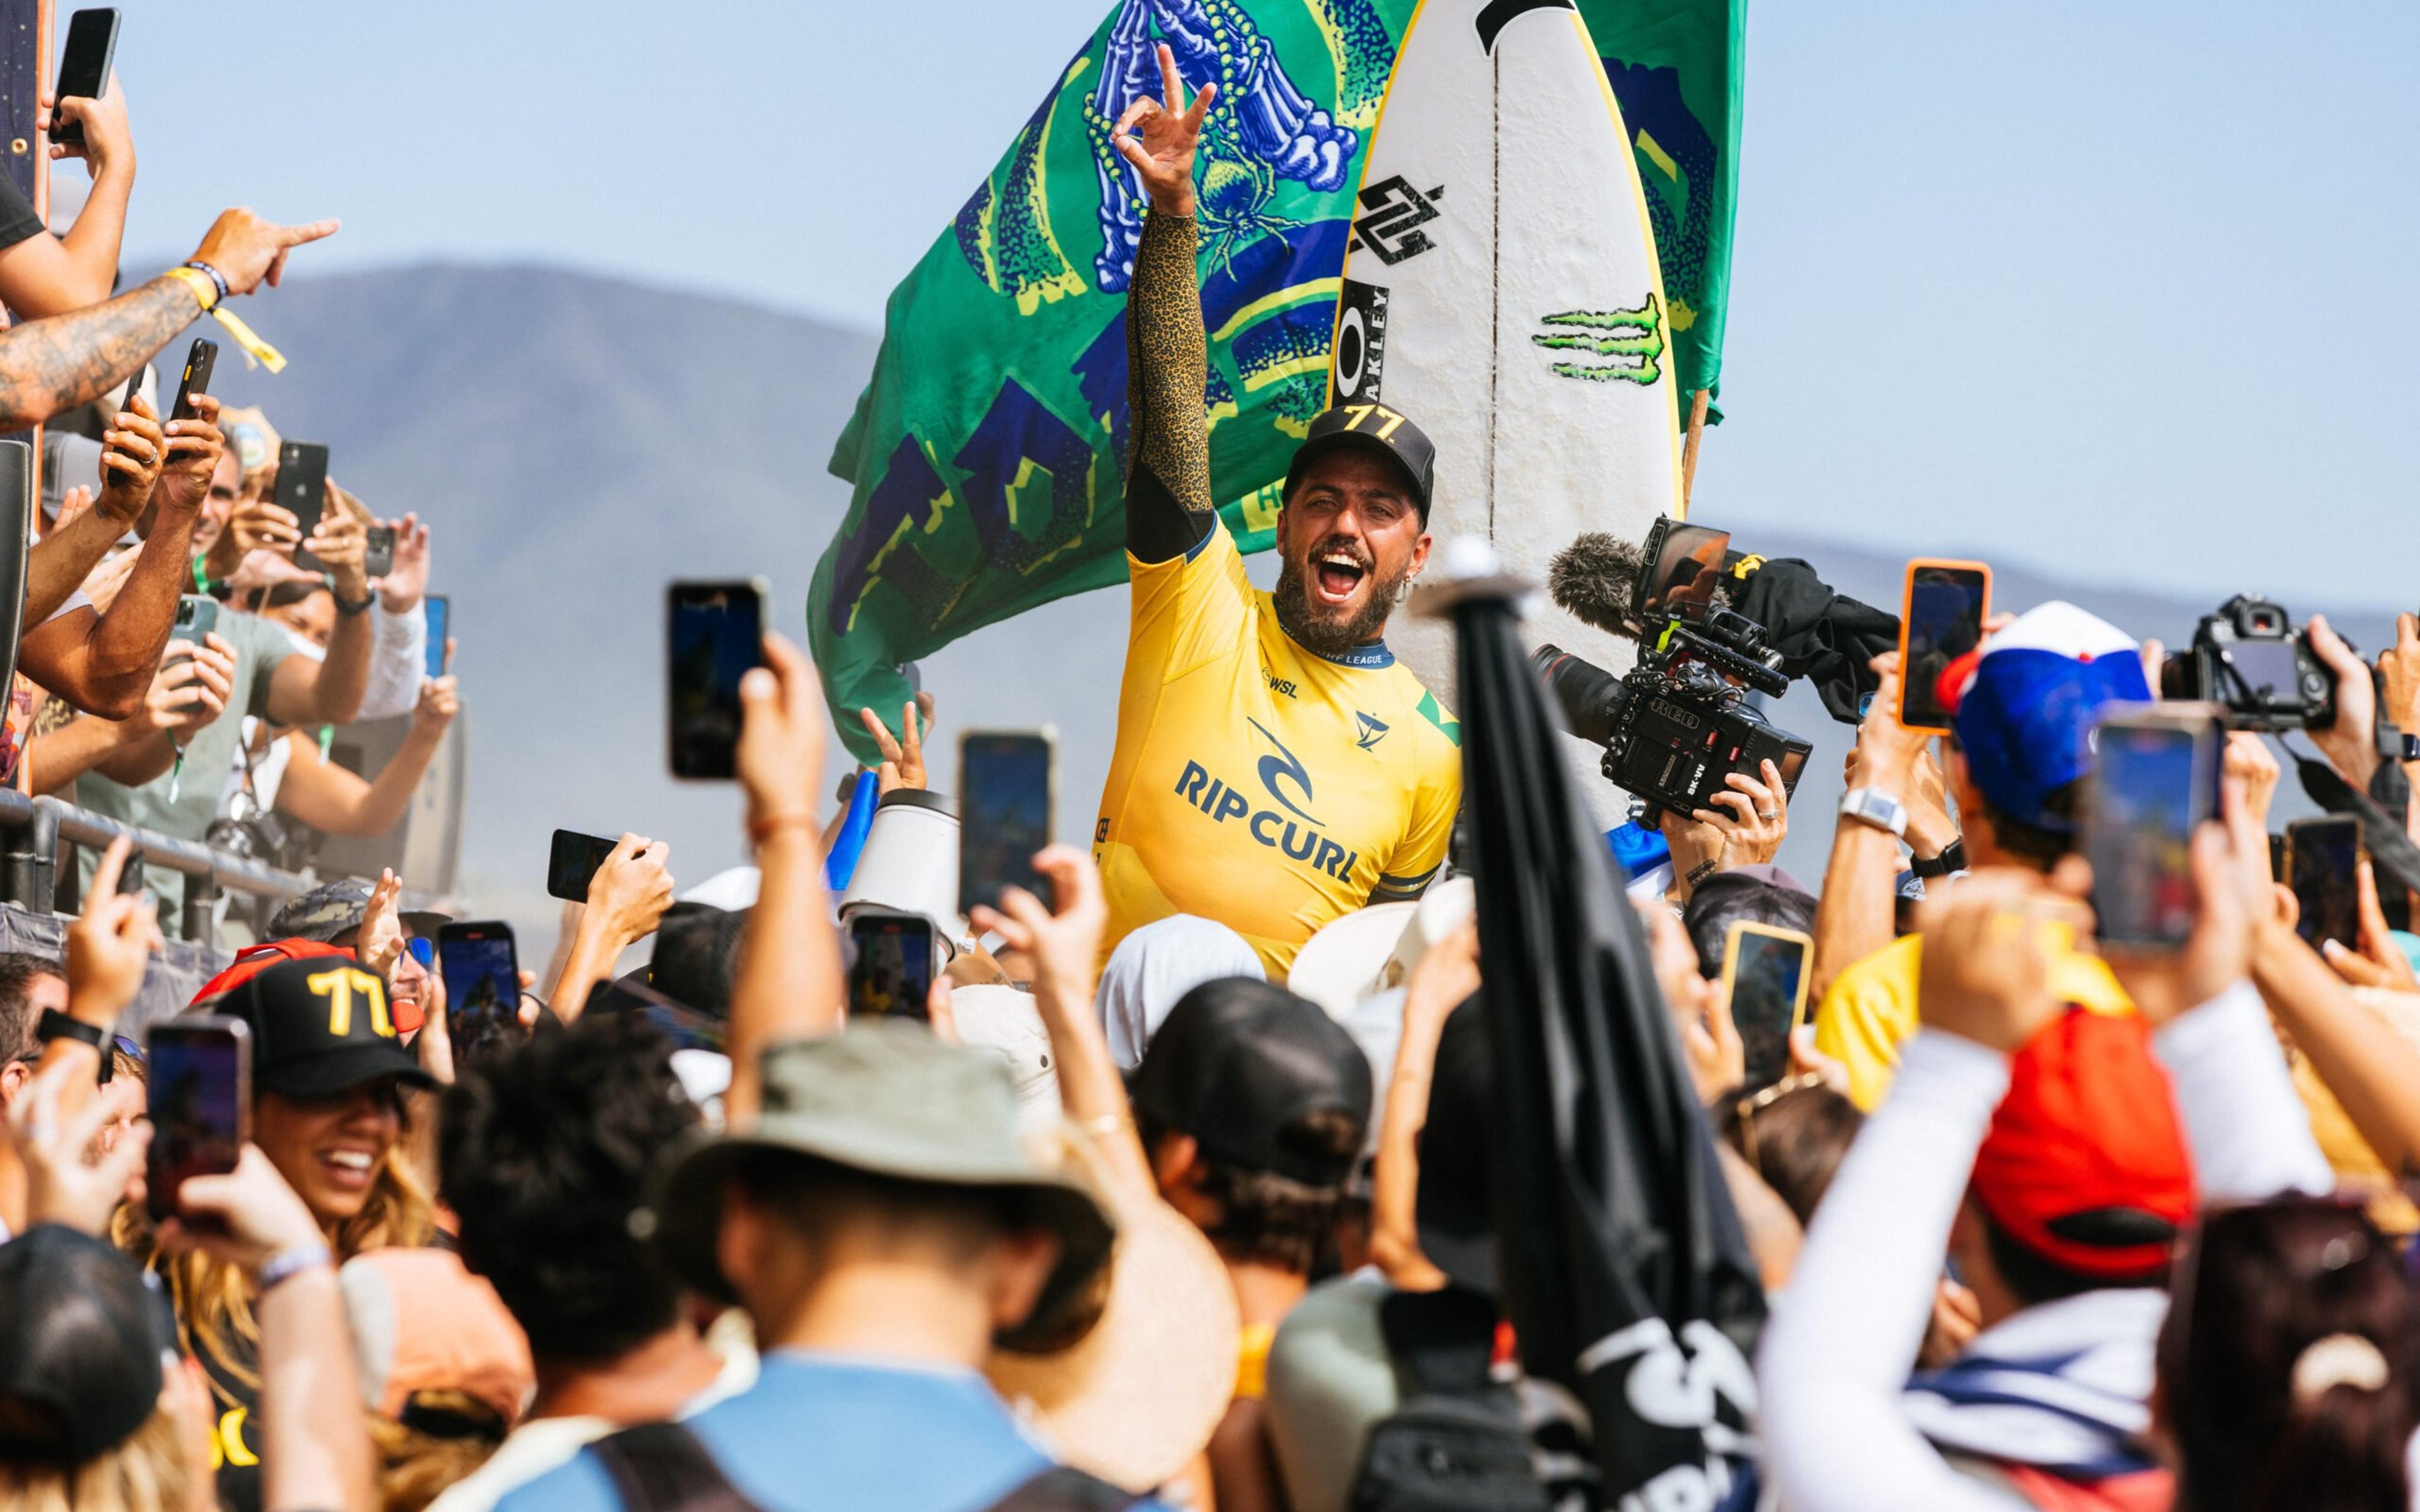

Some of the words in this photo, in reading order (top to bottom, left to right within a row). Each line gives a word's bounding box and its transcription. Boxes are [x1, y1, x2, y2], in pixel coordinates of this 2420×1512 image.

[1366, 290, 1388, 402] AKLEY
[1345, 654, 1383, 665] LEAGUE
[1270, 676, 1297, 699] WSL
[1651, 697, 1700, 730] RED
[1687, 763, 1705, 796] 8K-VV
[1174, 759, 1248, 823] RIP
[1250, 810, 1357, 884] CURL
